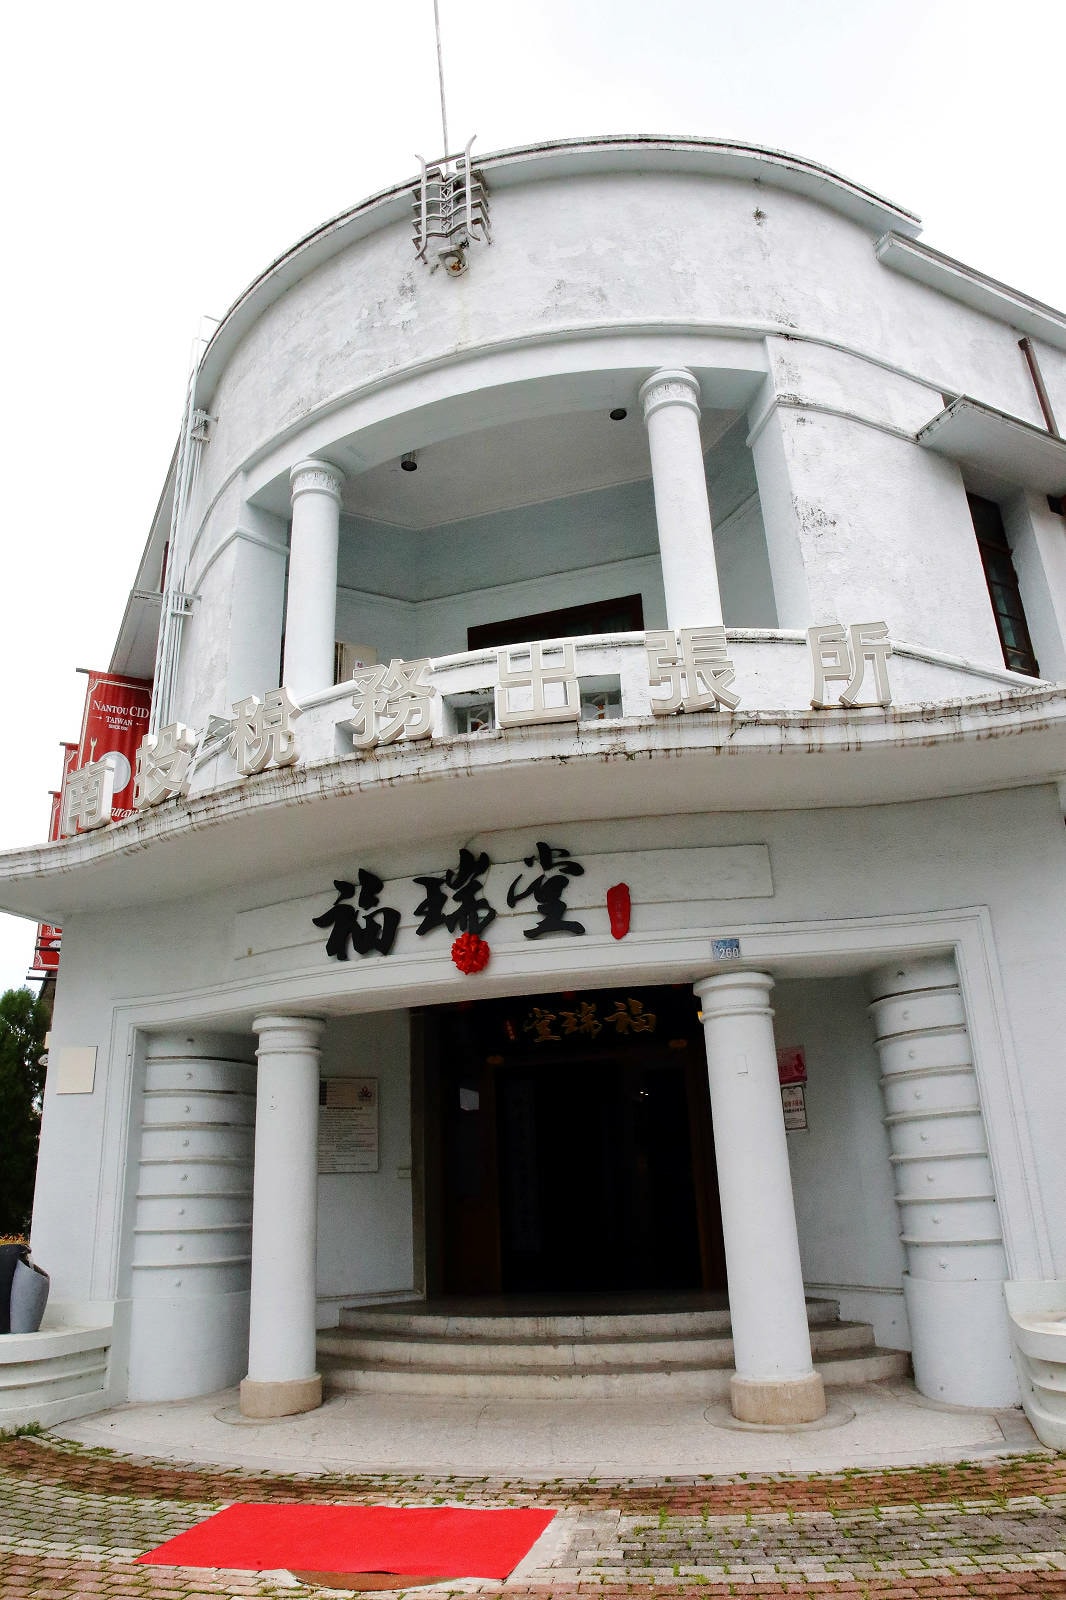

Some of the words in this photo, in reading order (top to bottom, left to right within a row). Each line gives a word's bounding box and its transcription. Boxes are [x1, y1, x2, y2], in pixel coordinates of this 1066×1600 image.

[129, 706, 150, 719] CID
[105, 715, 133, 727] TAIWAN
[312, 841, 585, 960] 福瑞堂
[719, 947, 739, 959] 260
